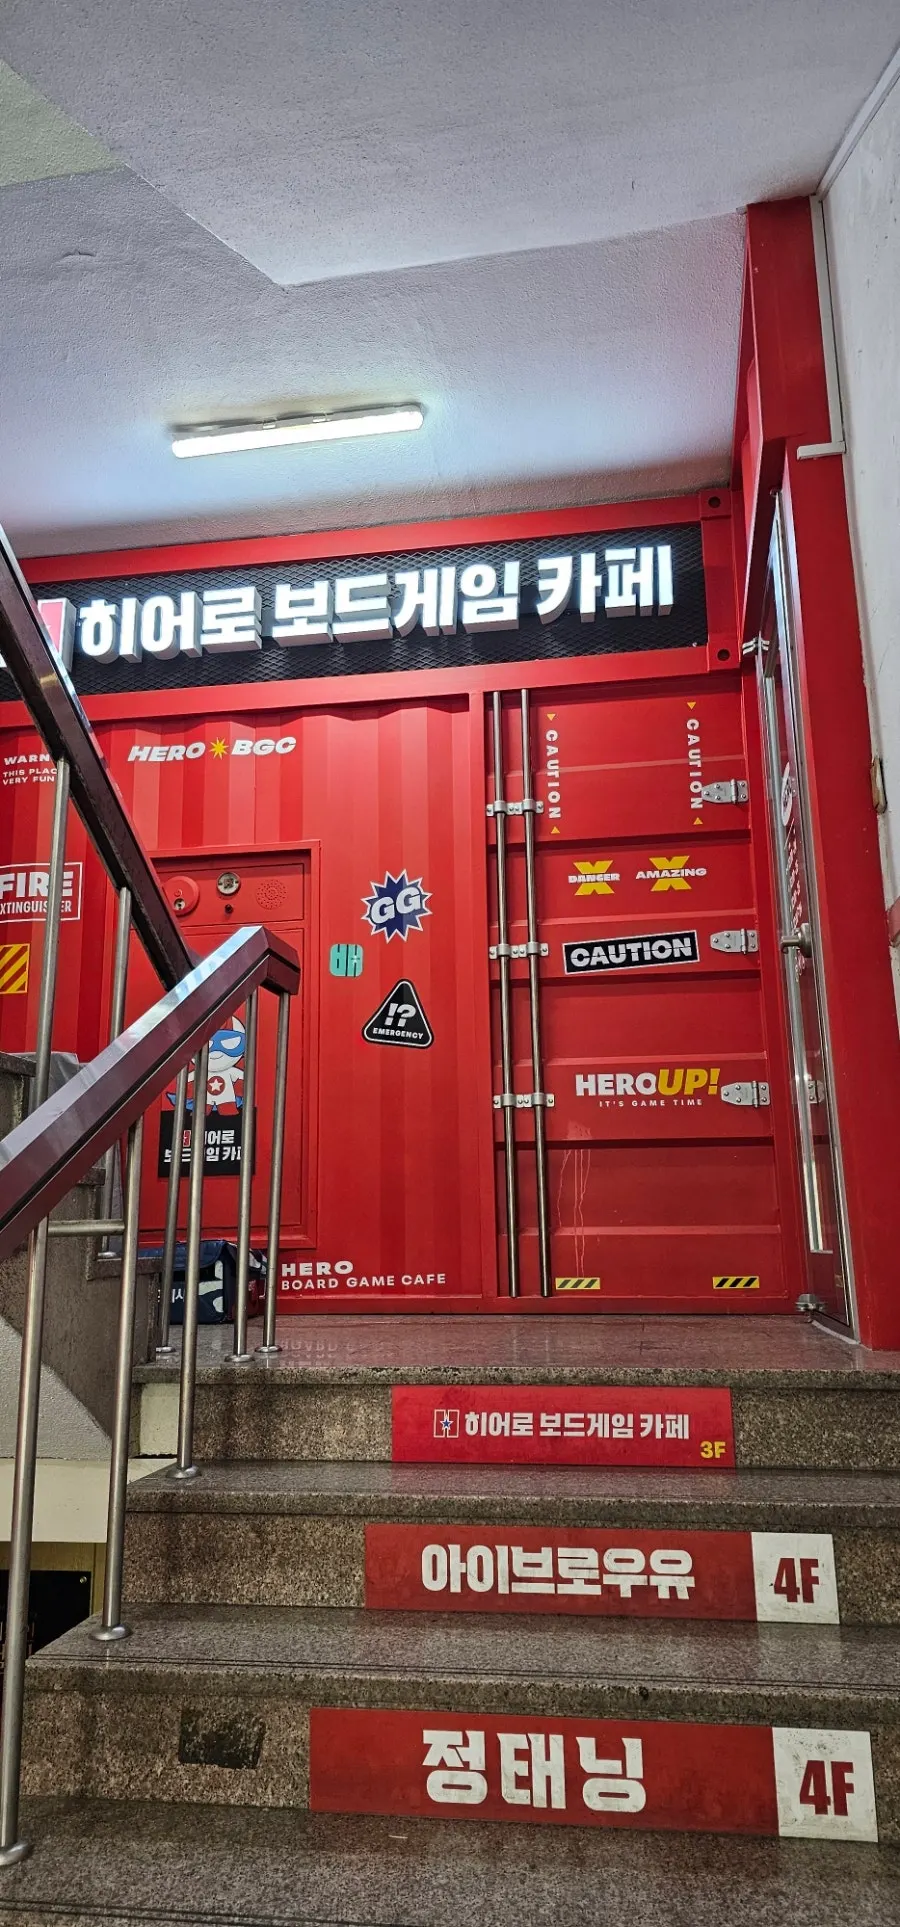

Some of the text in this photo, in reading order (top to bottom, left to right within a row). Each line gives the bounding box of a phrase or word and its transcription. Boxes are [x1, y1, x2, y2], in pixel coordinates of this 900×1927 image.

[79, 545, 673, 661] 히어로 보드게임 카페
[127, 737, 297, 762] HERO BGC
[4, 753, 50, 766] WARN
[686, 718, 703, 809] CAUTION
[3, 768, 57, 778] THIS PLAC
[3, 775, 55, 786] VERY FUN
[545, 729, 561, 819] CAUTION
[568, 873, 620, 884] DANGER
[636, 867, 707, 880] AMAZING
[0, 871, 73, 900] FIRE
[0, 900, 72, 915] XTINGUISER
[371, 886, 421, 924] GG
[570, 937, 692, 967] CAUTION
[372, 1027, 424, 1040] EMERGENCY
[673, 1098, 702, 1106] TIME
[204, 1129, 235, 1145] 어로
[281, 1260, 353, 1277] HERO
[281, 1274, 446, 1290] BOARD GAME CAFE
[465, 1411, 534, 1437] 히어로
[539, 1412, 634, 1439] 보드게임
[640, 1413, 690, 1440] 카페
[700, 1441, 726, 1459] 3F
[421, 1543, 819, 1603] 아이브로우유 4F
[422, 1729, 855, 1817] 정태닝 4F
